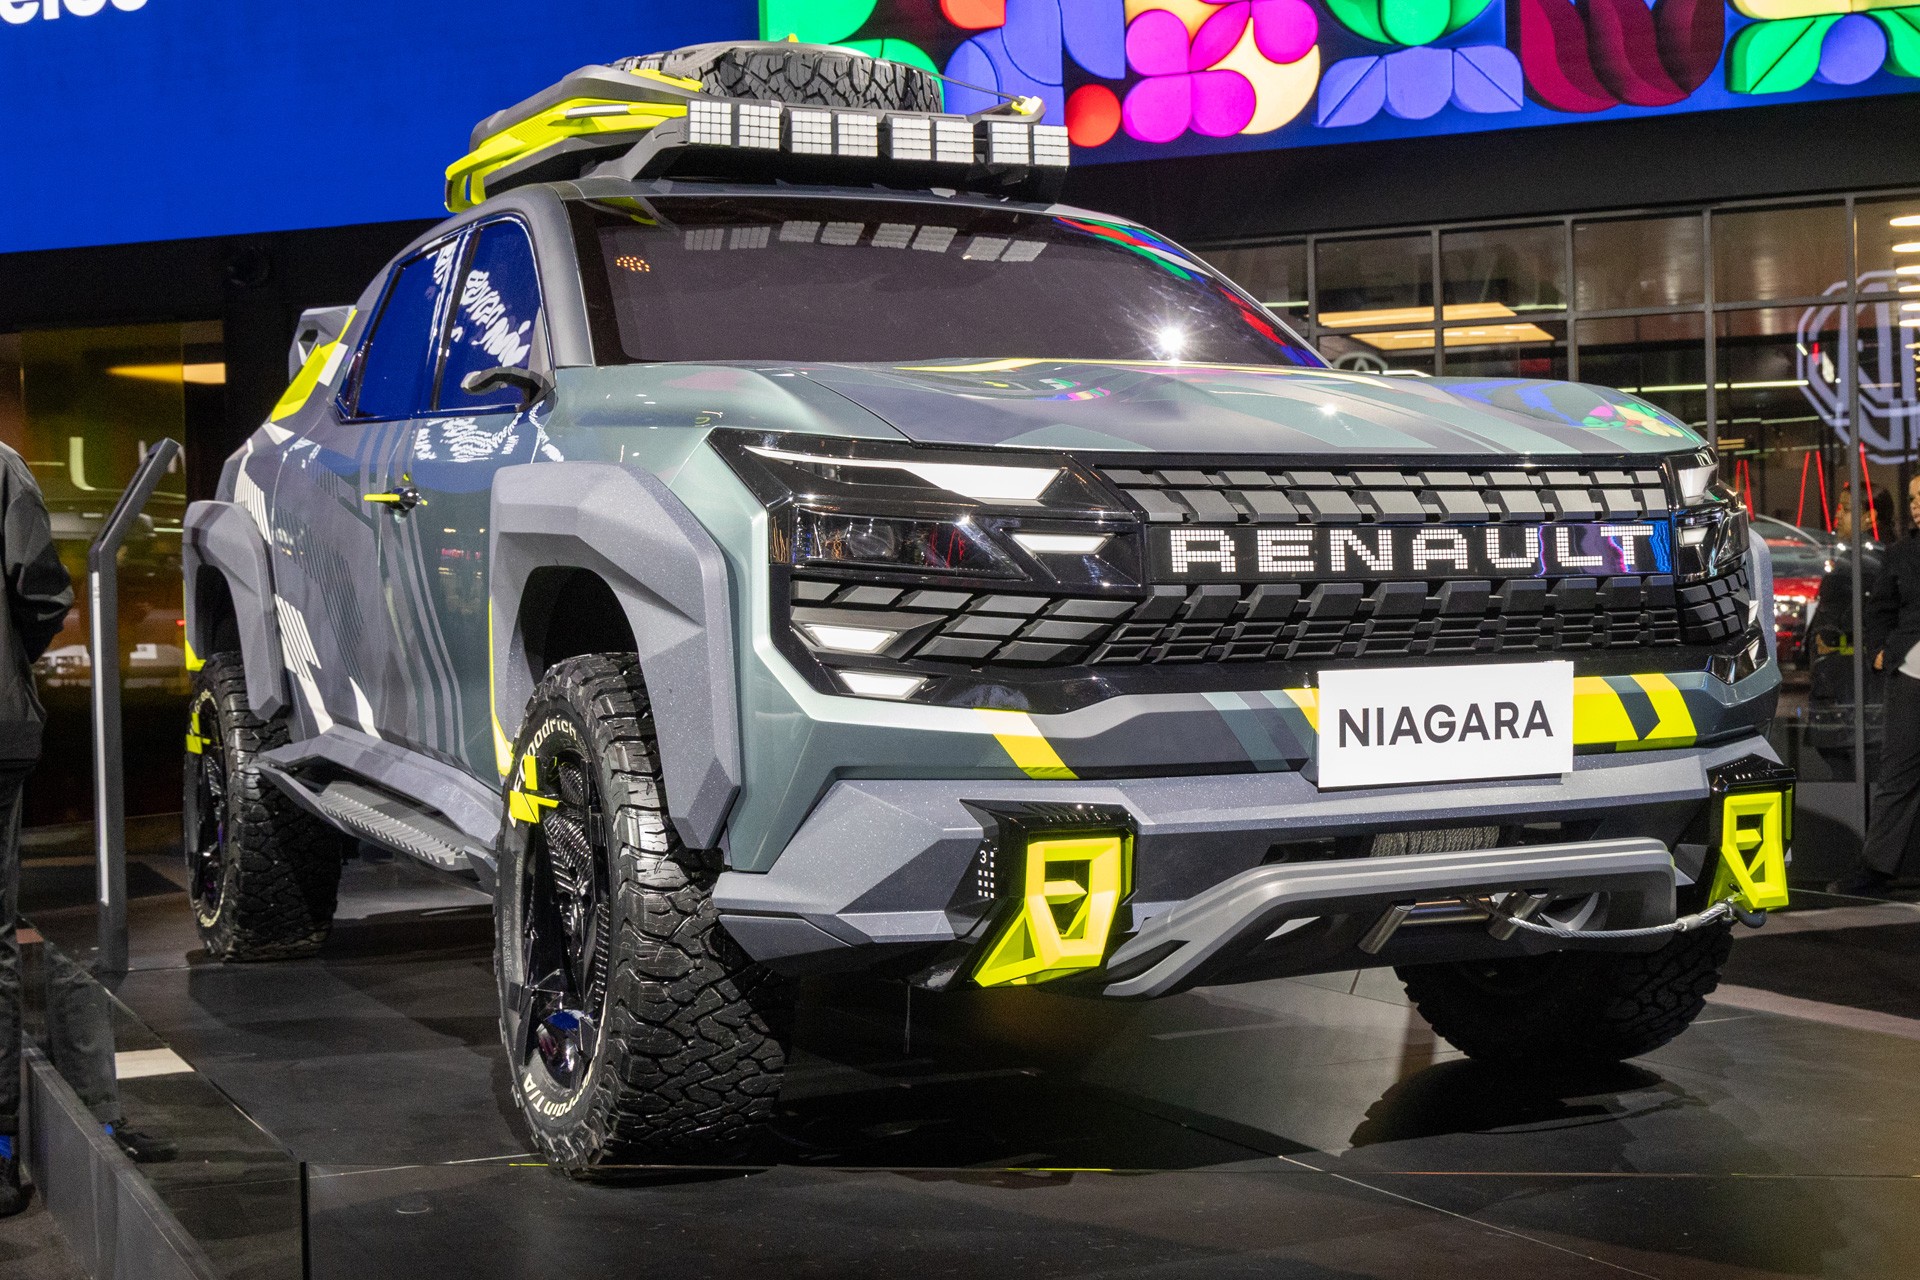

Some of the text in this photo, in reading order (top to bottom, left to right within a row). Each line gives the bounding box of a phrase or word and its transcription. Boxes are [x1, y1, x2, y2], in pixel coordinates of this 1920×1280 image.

[1170, 525, 1654, 574] RENAULT
[1338, 699, 1554, 748] NIAGARA
[979, 849, 987, 864] 3
